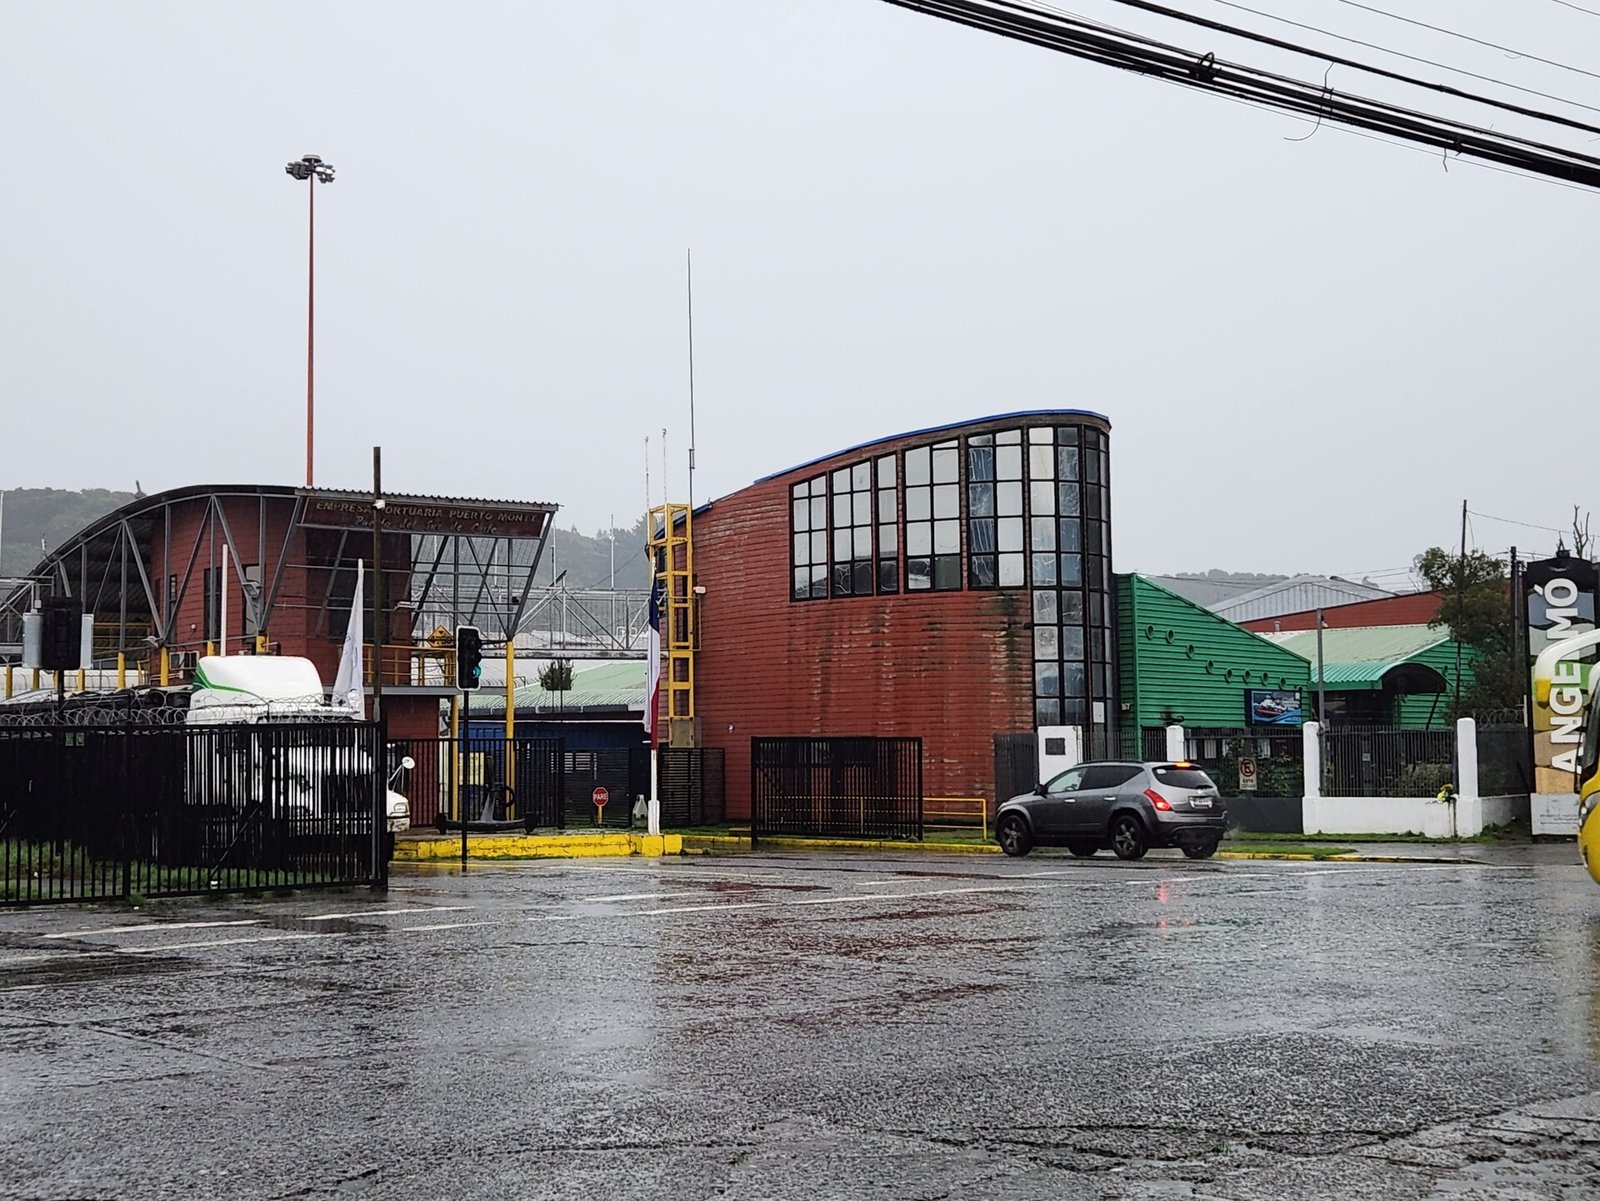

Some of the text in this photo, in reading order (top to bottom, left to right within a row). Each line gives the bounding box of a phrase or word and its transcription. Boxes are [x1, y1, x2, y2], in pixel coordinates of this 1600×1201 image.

[316, 502, 372, 514] EMPRESA
[380, 505, 443, 518] ORTUARIA
[449, 509, 493, 520] PUERTO
[355, 515, 391, 529] Pueta
[1534, 577, 1584, 775] ANGEMÓ
